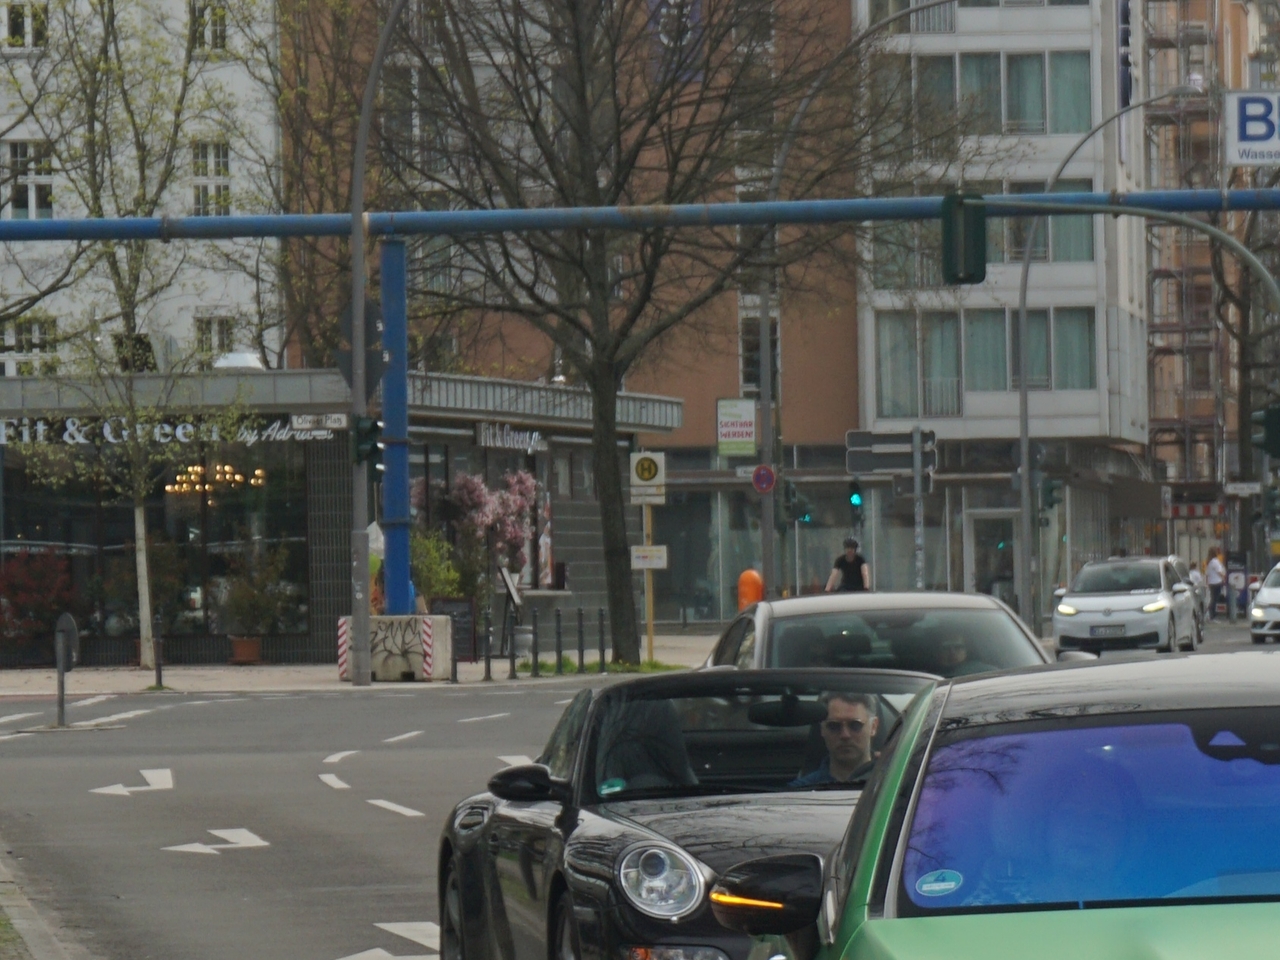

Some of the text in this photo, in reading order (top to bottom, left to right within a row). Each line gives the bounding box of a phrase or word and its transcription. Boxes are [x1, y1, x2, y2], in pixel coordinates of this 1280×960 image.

[0, 418, 48, 444] Fit
[62, 417, 95, 444] &
[640, 462, 652, 475] H
